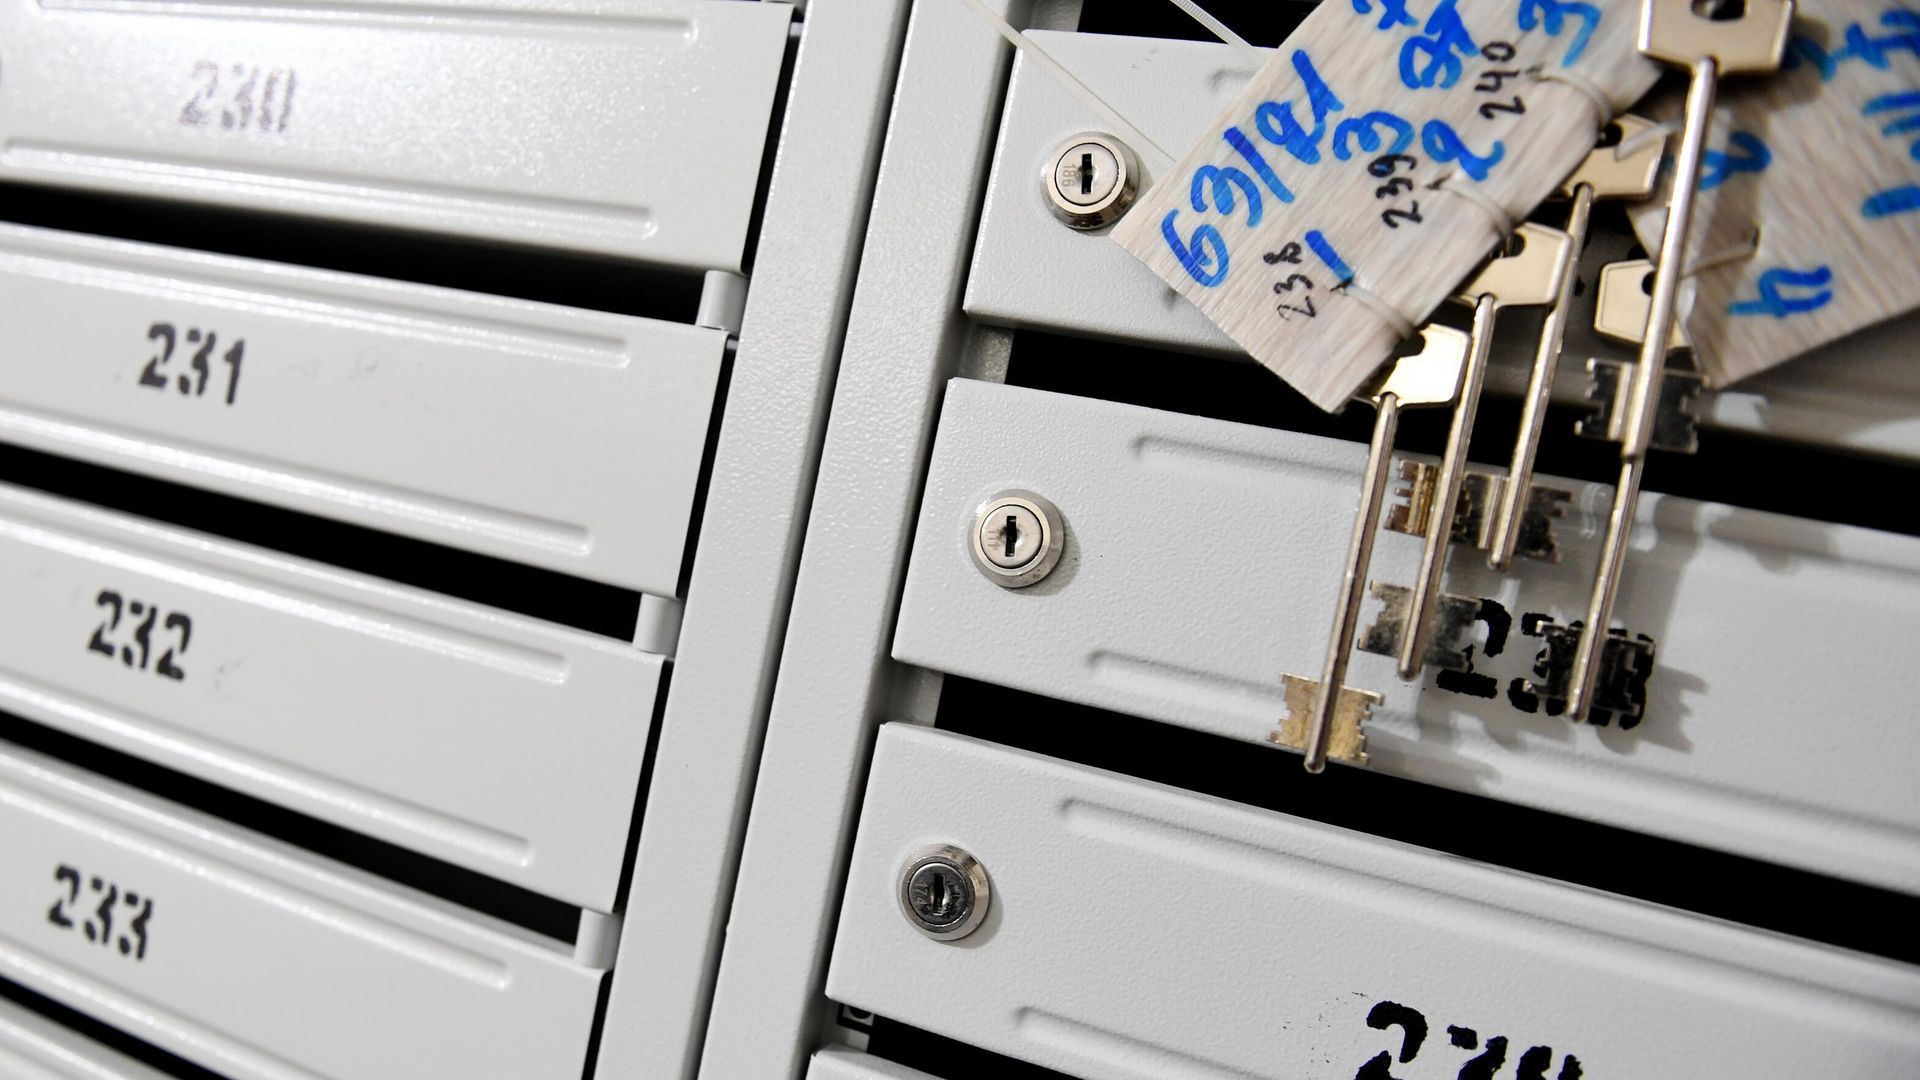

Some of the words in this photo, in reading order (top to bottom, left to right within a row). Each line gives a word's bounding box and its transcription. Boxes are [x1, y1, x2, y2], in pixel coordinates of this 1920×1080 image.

[179, 60, 297, 132] 230
[1473, 41, 1526, 120] 240
[1062, 163, 1077, 187] 186
[1367, 152, 1423, 229] 239
[1263, 242, 1317, 320] 238
[1728, 266, 1833, 318] 4
[138, 323, 245, 405] 231
[87, 589, 193, 682] 232
[47, 864, 154, 961] 233
